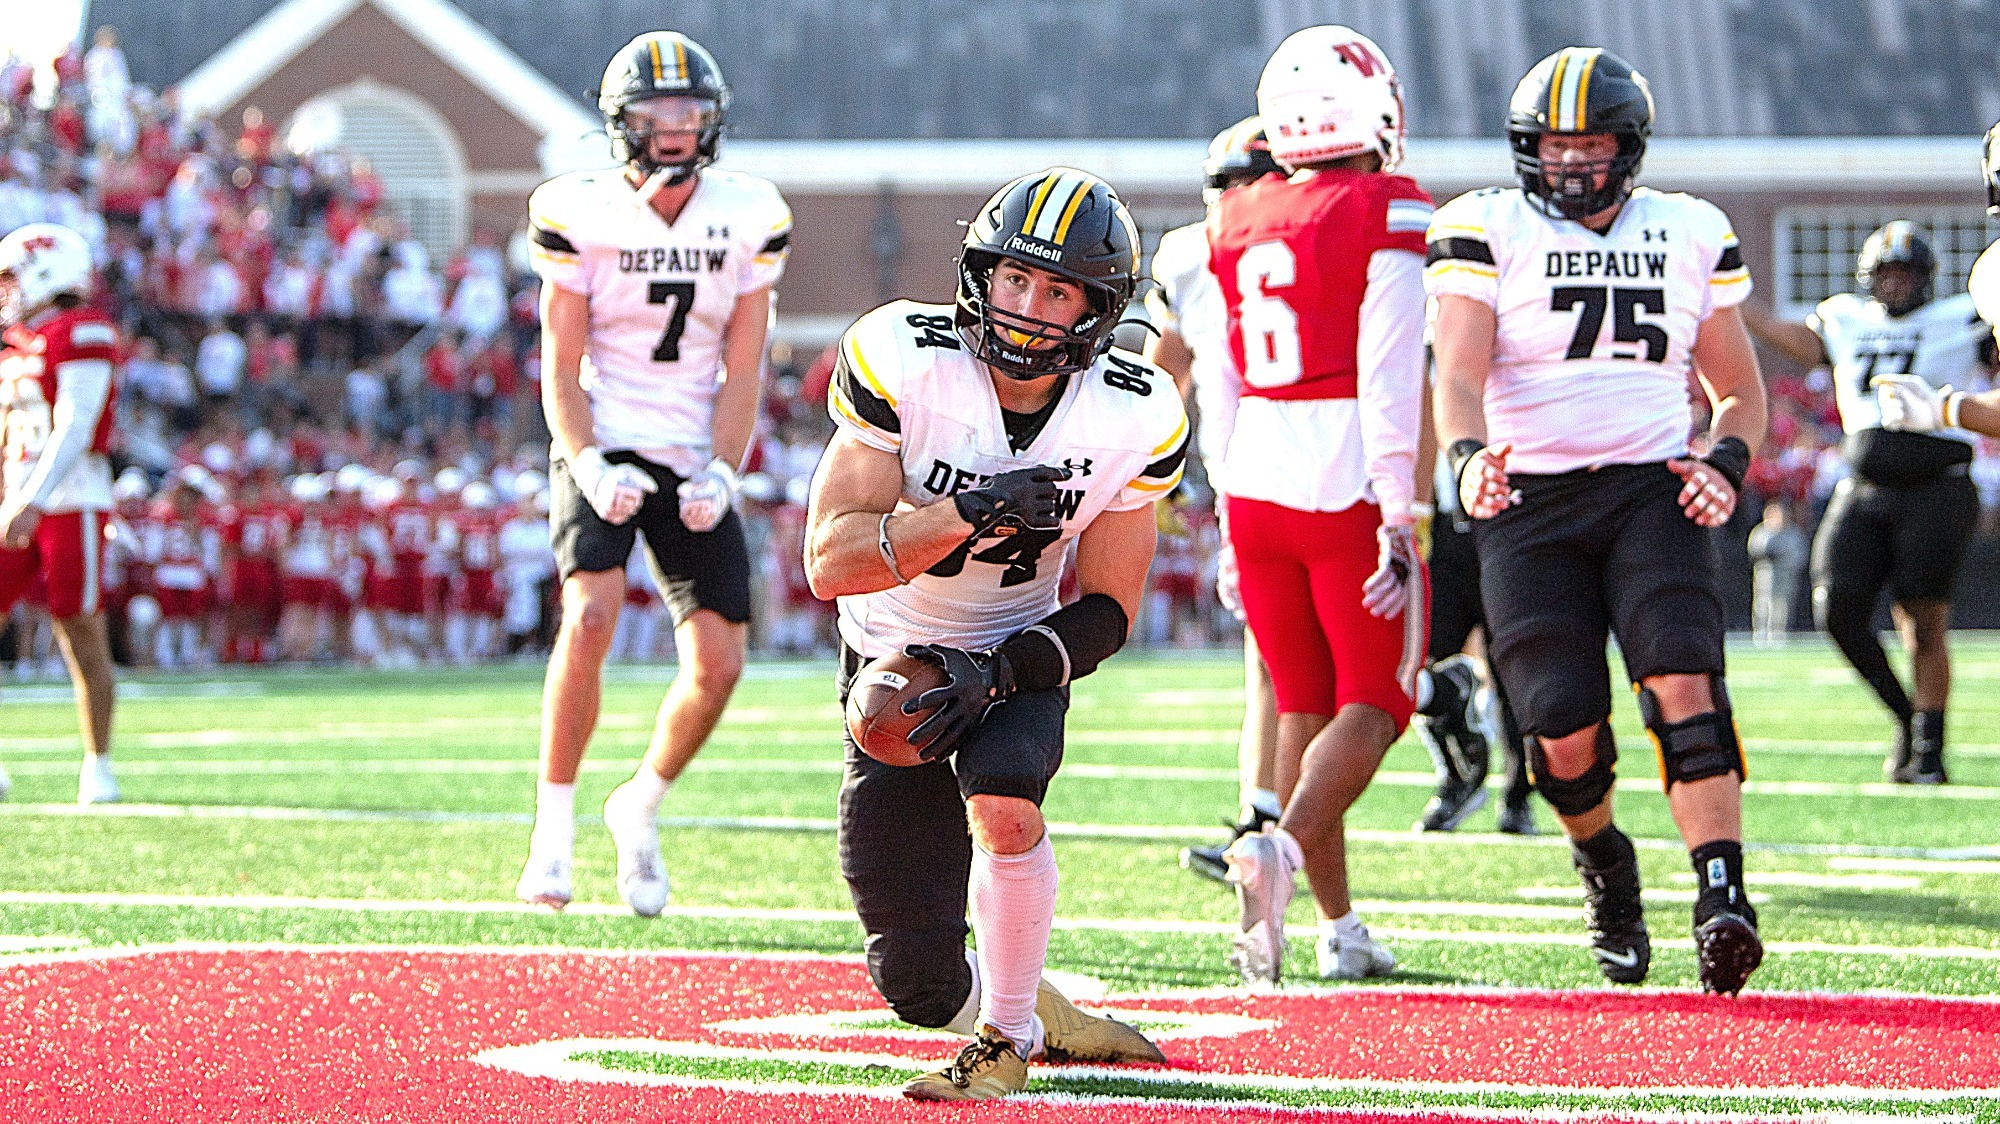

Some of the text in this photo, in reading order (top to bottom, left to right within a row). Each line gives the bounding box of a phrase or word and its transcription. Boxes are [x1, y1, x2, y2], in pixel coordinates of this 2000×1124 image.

[619, 246, 727, 273] DEPAUW
[1011, 236, 1063, 263] Riddell
[1545, 250, 1666, 279] DEPAUW
[963, 270, 984, 302] Ridde
[647, 280, 695, 362] 7
[905, 313, 962, 351] 84
[1236, 239, 1304, 389] 6
[1550, 285, 1668, 363] 75
[1103, 353, 1155, 397] 84
